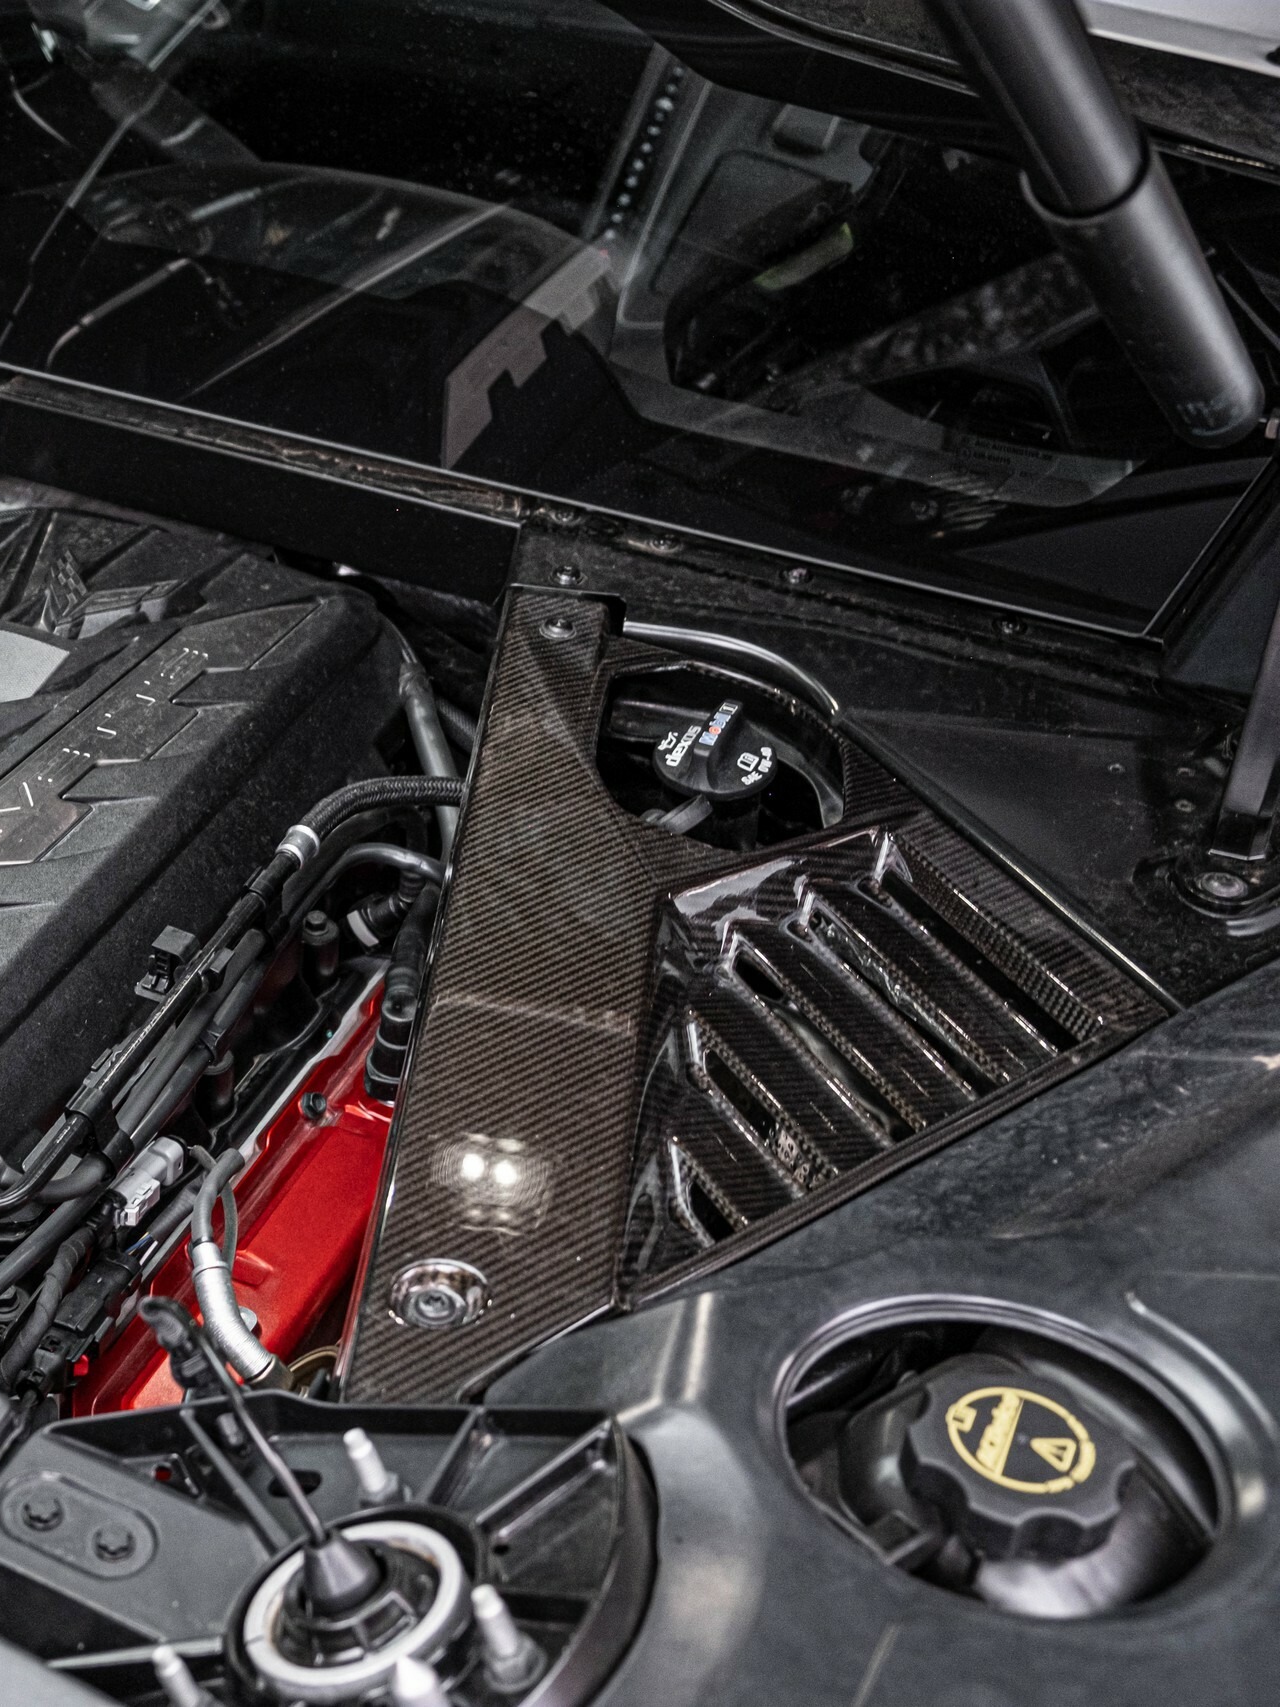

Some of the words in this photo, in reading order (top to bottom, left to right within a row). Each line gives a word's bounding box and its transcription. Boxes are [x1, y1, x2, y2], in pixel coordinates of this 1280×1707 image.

[665, 725, 702, 767] dexos
[698, 711, 732, 746] Mobil
[741, 771, 763, 786] SAE
